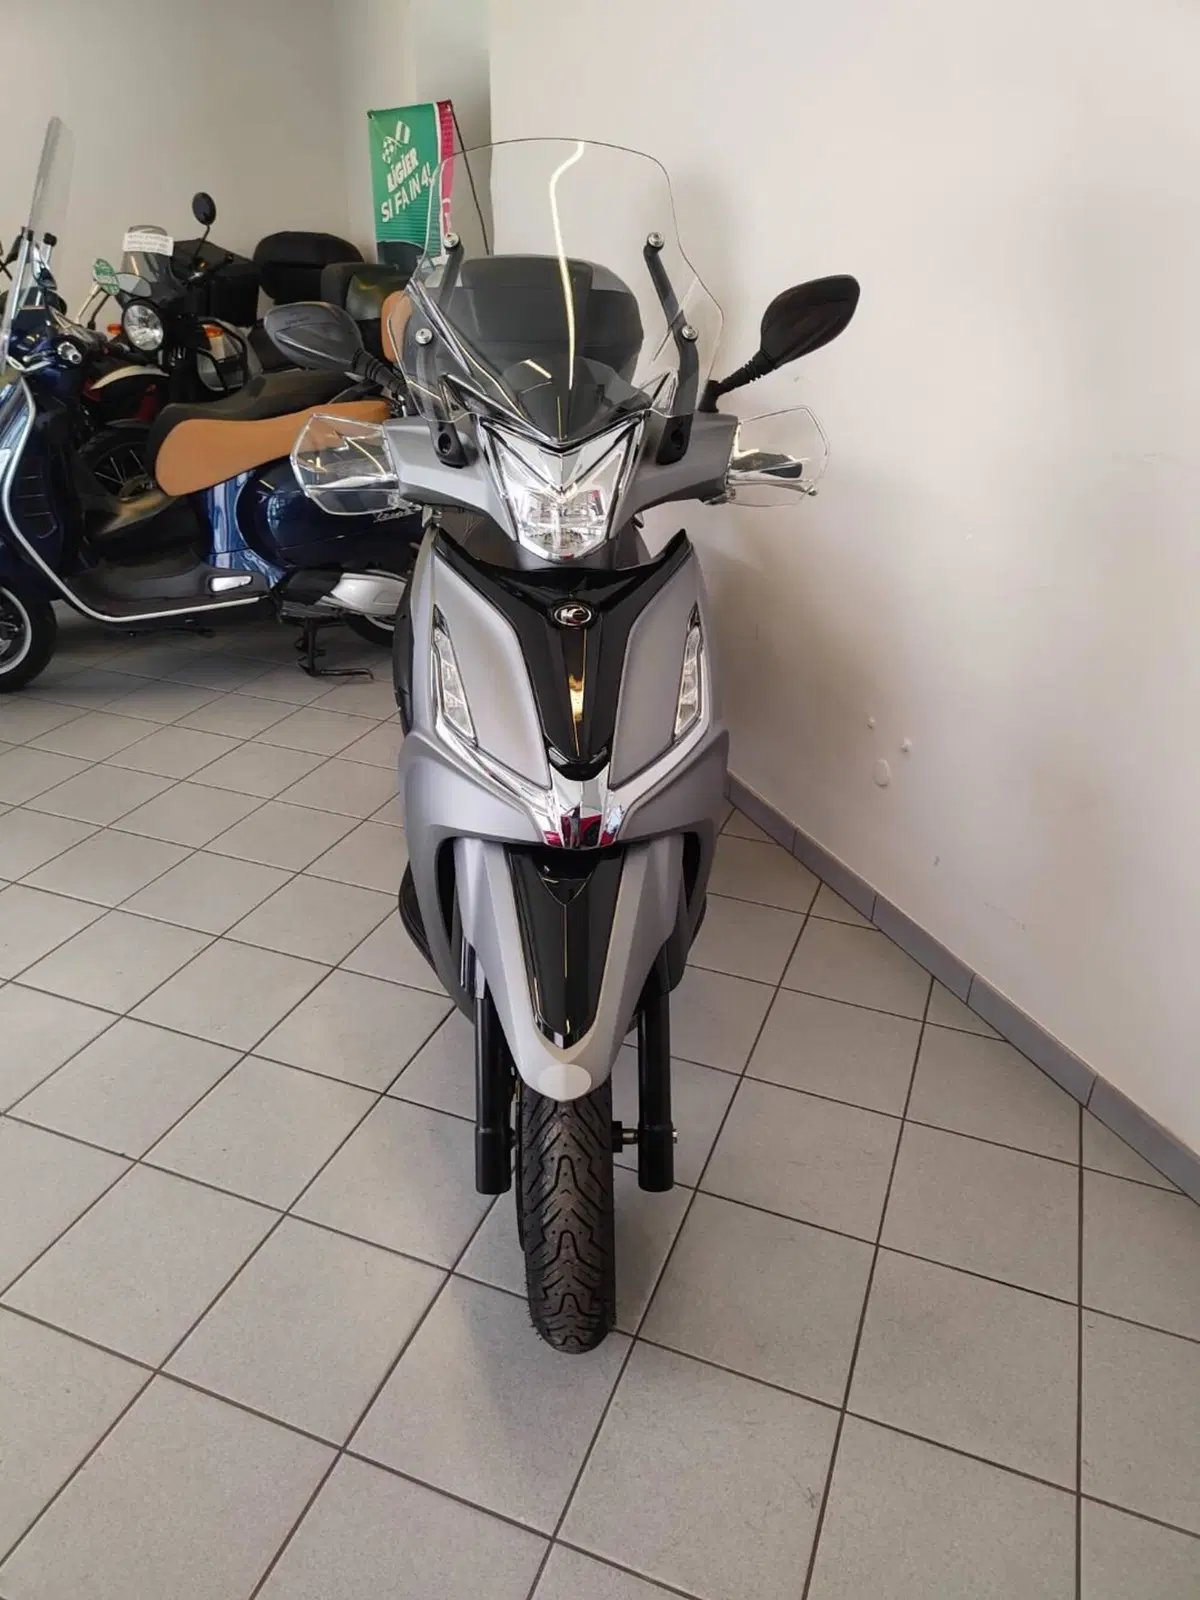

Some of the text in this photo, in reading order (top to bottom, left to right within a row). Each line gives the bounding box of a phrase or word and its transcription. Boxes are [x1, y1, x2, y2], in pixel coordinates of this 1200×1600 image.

[381, 198, 394, 223] SI
[394, 186, 410, 215] FA
[409, 172, 422, 201] IN
